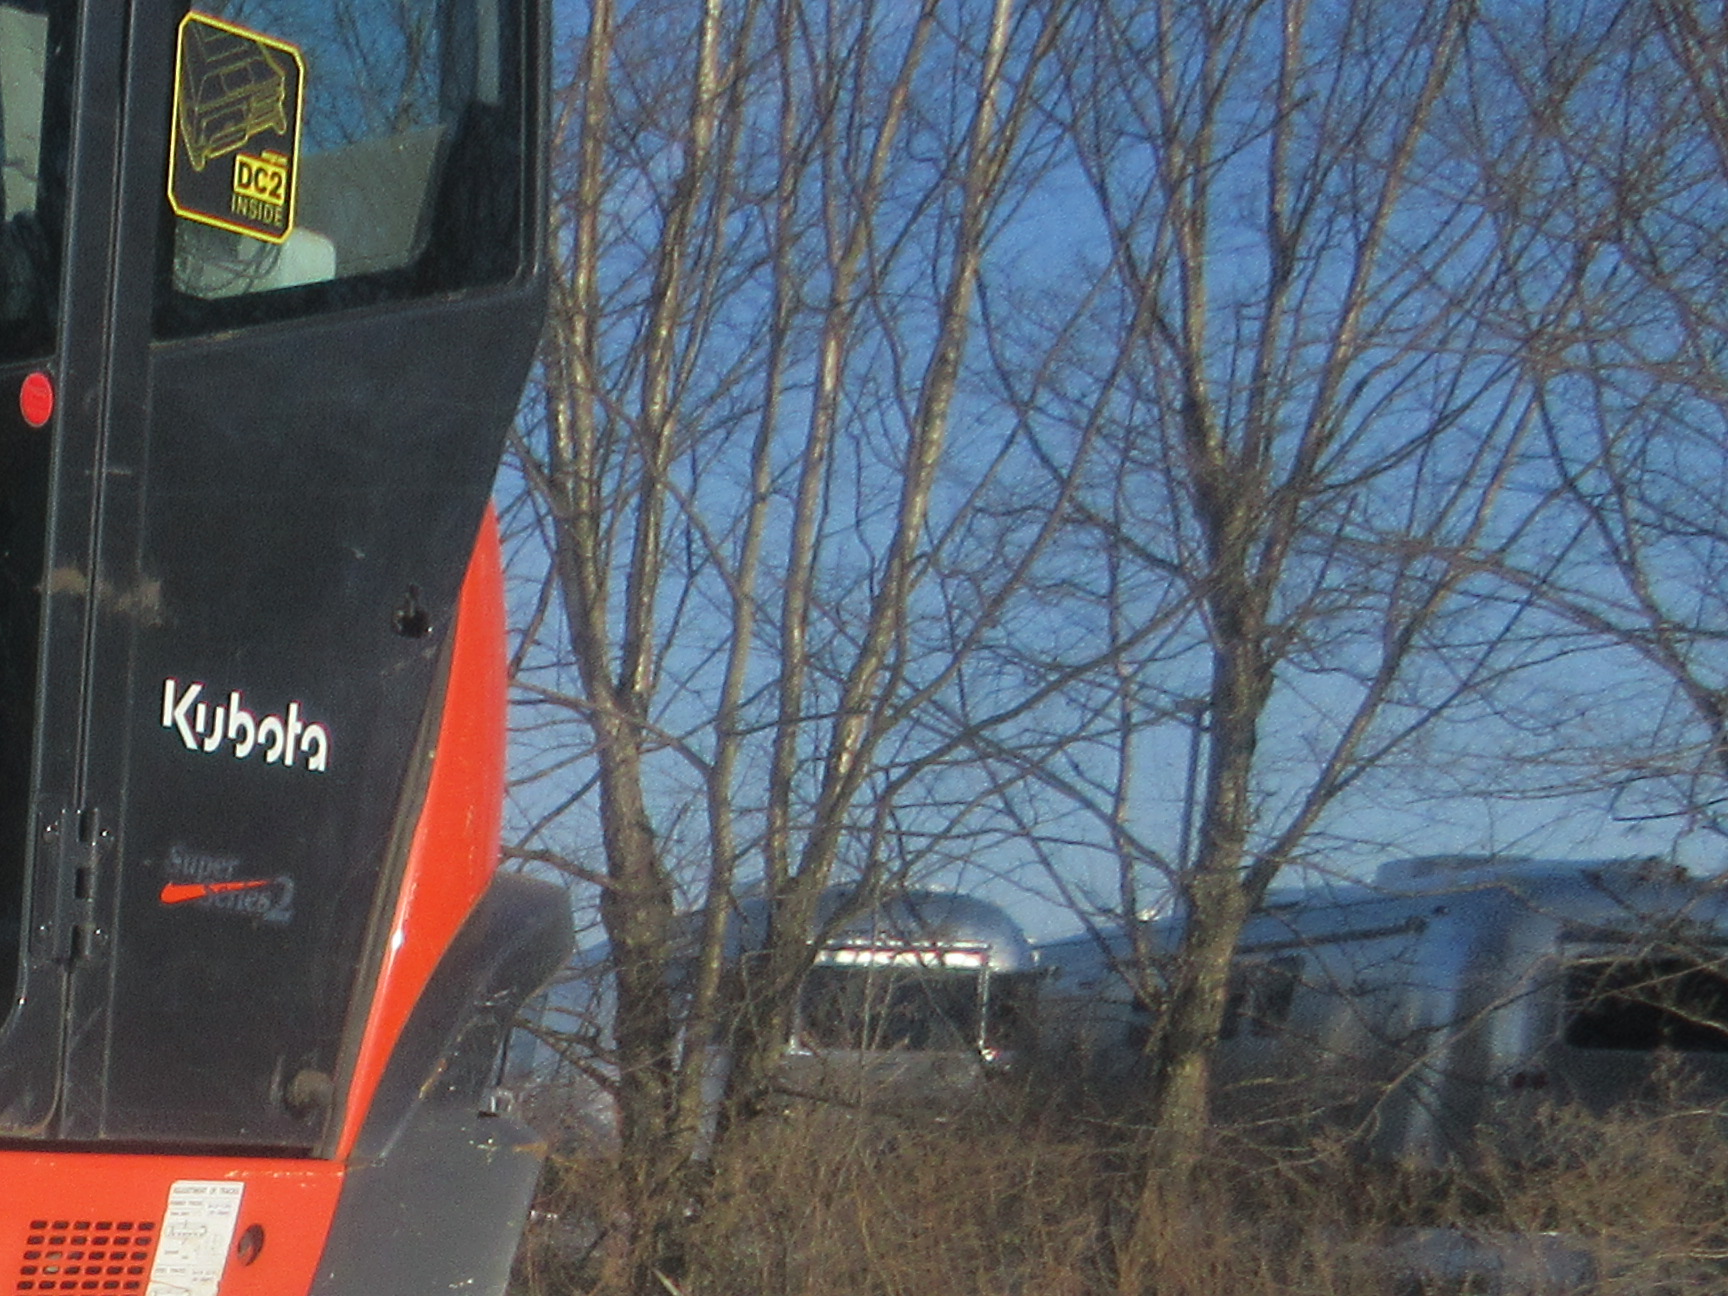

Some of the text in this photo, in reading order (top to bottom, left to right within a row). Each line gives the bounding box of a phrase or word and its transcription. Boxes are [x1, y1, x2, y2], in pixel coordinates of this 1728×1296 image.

[237, 160, 283, 200] DC2
[231, 194, 284, 228] INSIDE
[161, 677, 330, 773] Kubota
